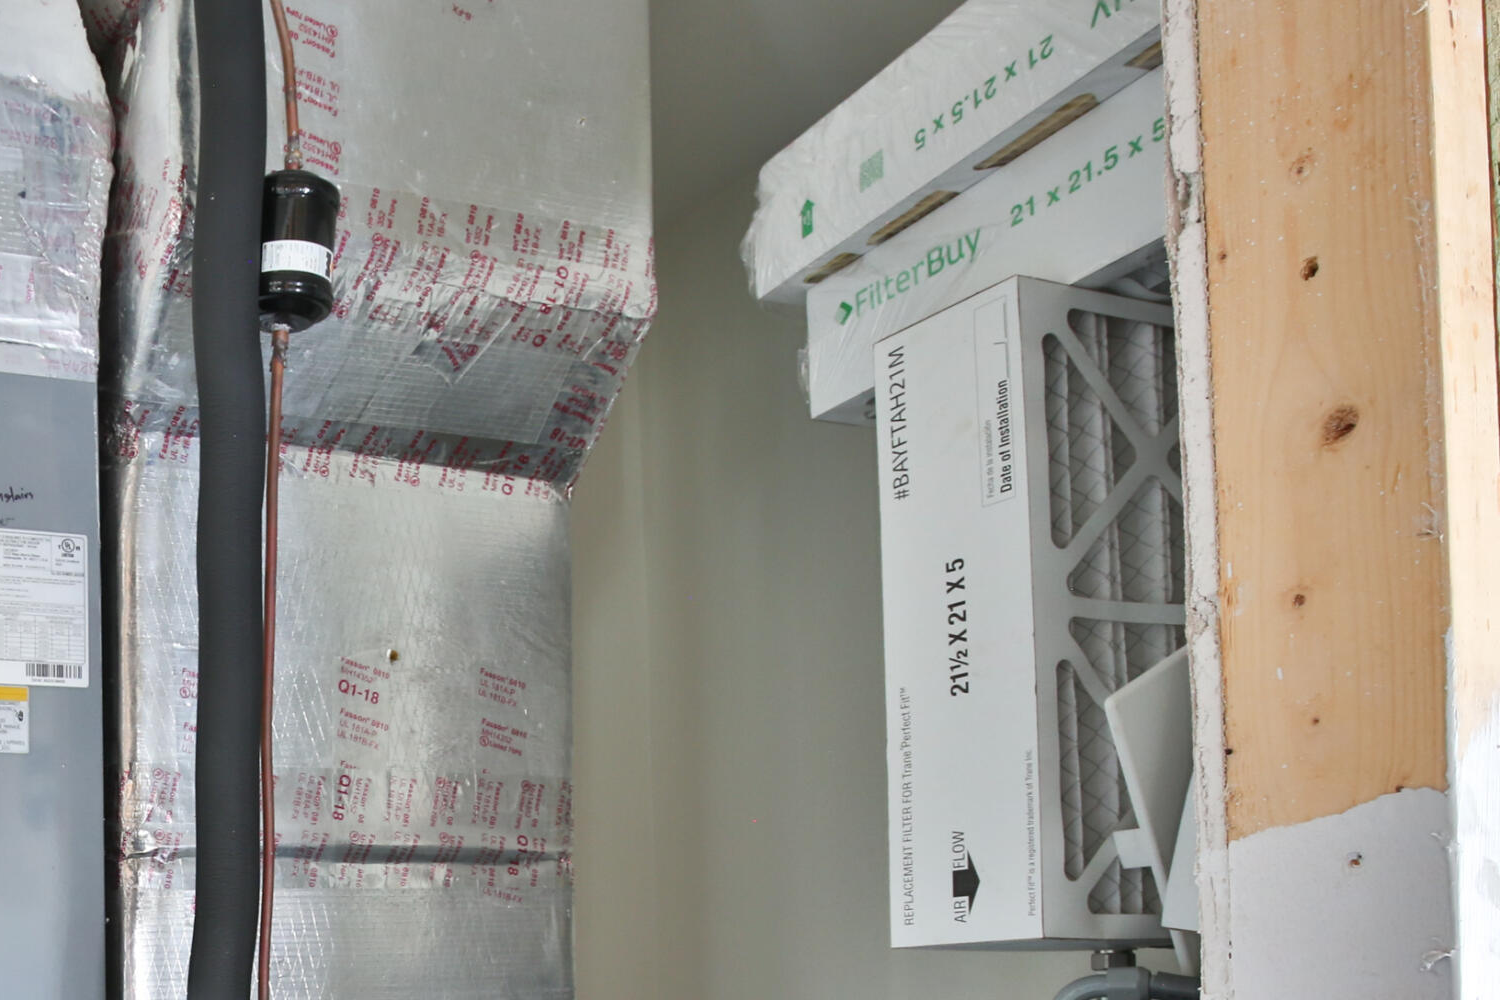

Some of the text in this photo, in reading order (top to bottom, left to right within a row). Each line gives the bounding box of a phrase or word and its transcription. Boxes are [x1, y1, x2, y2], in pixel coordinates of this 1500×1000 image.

[1010, 195, 1036, 227] 21
[1068, 145, 1119, 195] 21.5
[855, 227, 982, 317] FilterBuy
[888, 345, 910, 501] #BAYFTAH21M
[996, 380, 1012, 493] Date of Installation
[946, 558, 964, 573] 5
[947, 578, 965, 593] X
[948, 600, 967, 626] 21
[949, 630, 968, 646] X
[338, 679, 380, 704] Q1-18
[332, 774, 351, 821] Q1-18
[902, 782, 912, 803] FOR
[902, 805, 913, 844] FILTER
[903, 846, 914, 926] REPLACEMENT
[952, 831, 967, 923] AIR FLOW
